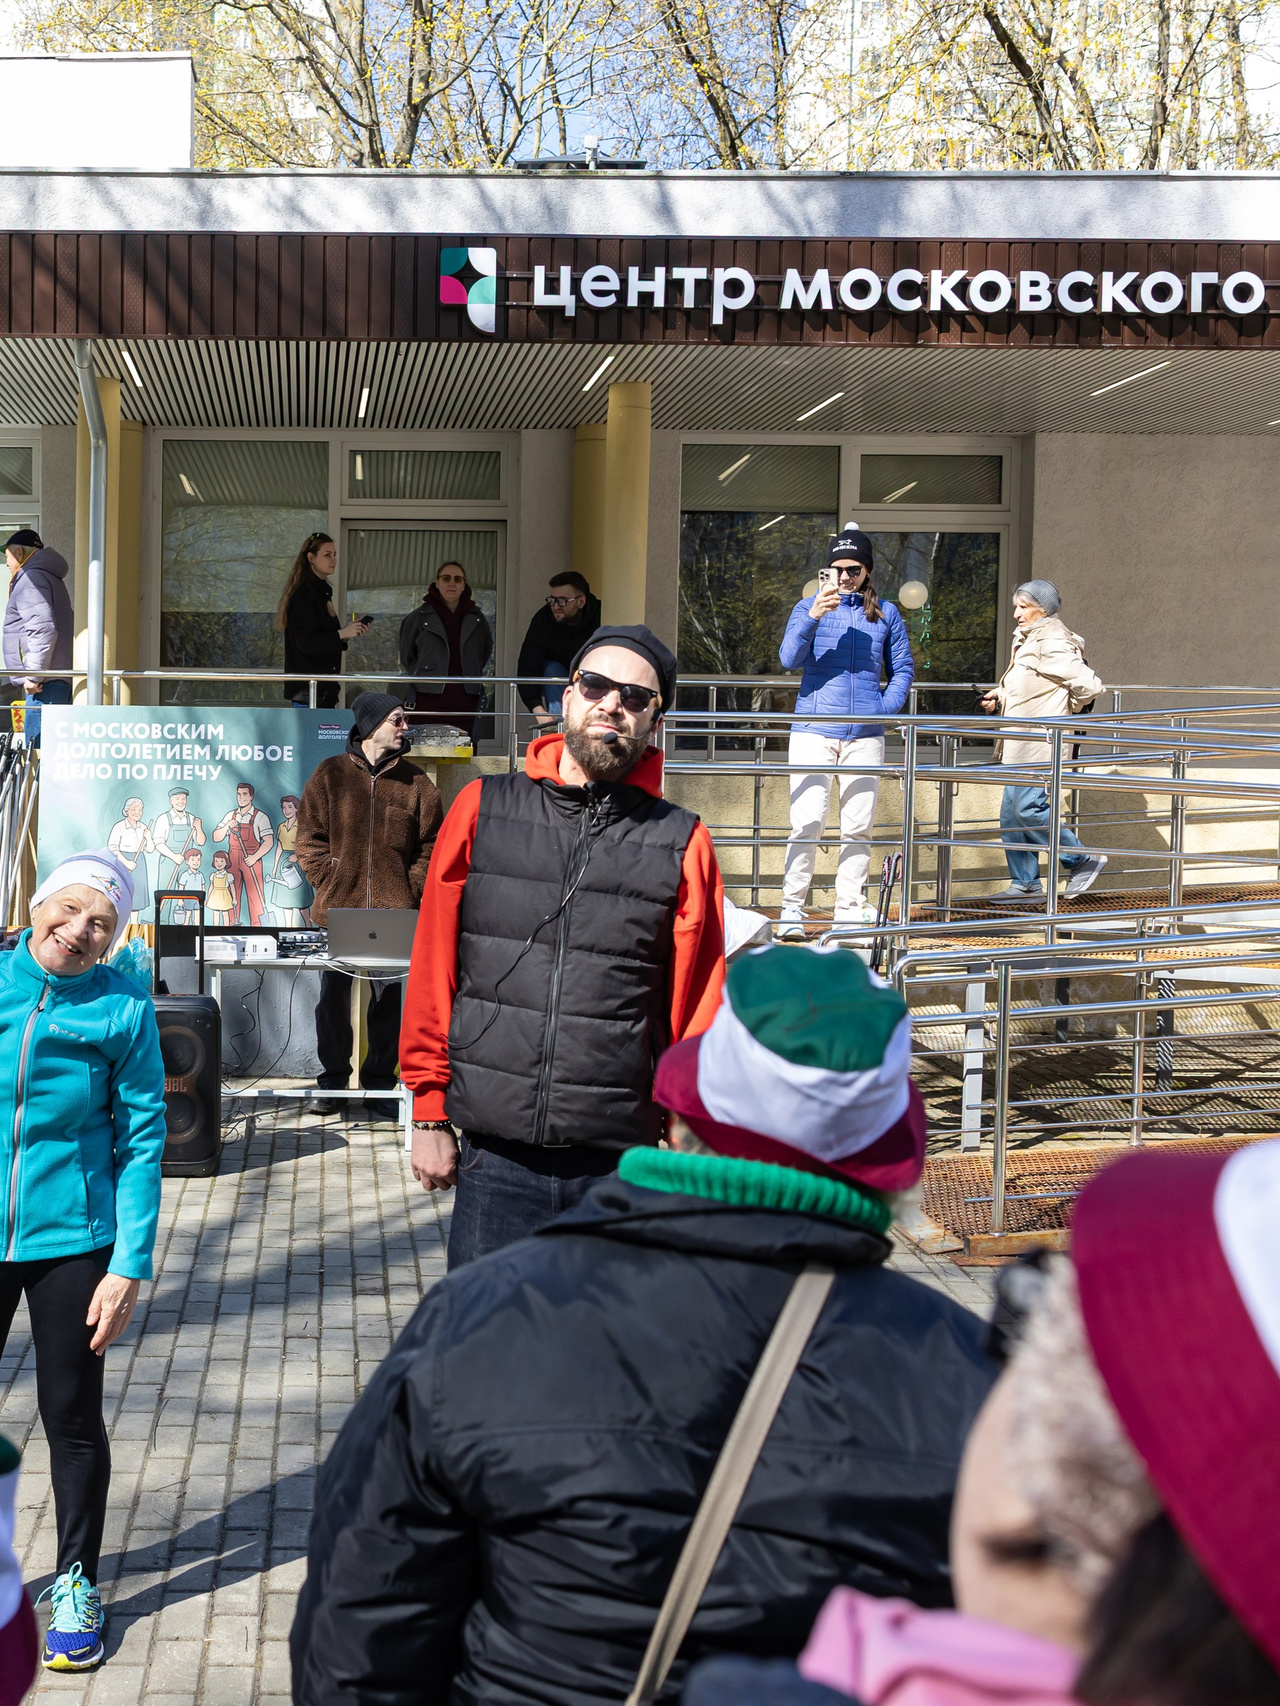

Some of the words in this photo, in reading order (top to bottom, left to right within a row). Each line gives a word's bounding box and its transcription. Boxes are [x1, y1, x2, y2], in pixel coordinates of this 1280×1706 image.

[533, 264, 756, 325] центр
[779, 268, 1266, 314] московского
[54, 721, 68, 739] С
[73, 722, 224, 740] МОСКОВСКИМ
[54, 742, 211, 761] ДОЛГОЛЕТИЕМ
[215, 744, 294, 762] ЛЮБОЕ
[53, 763, 112, 782] ДЕЛО
[117, 764, 148, 780] ПО
[153, 764, 222, 781] ПЛЕЧУ
[164, 1078, 187, 1092] JBL
